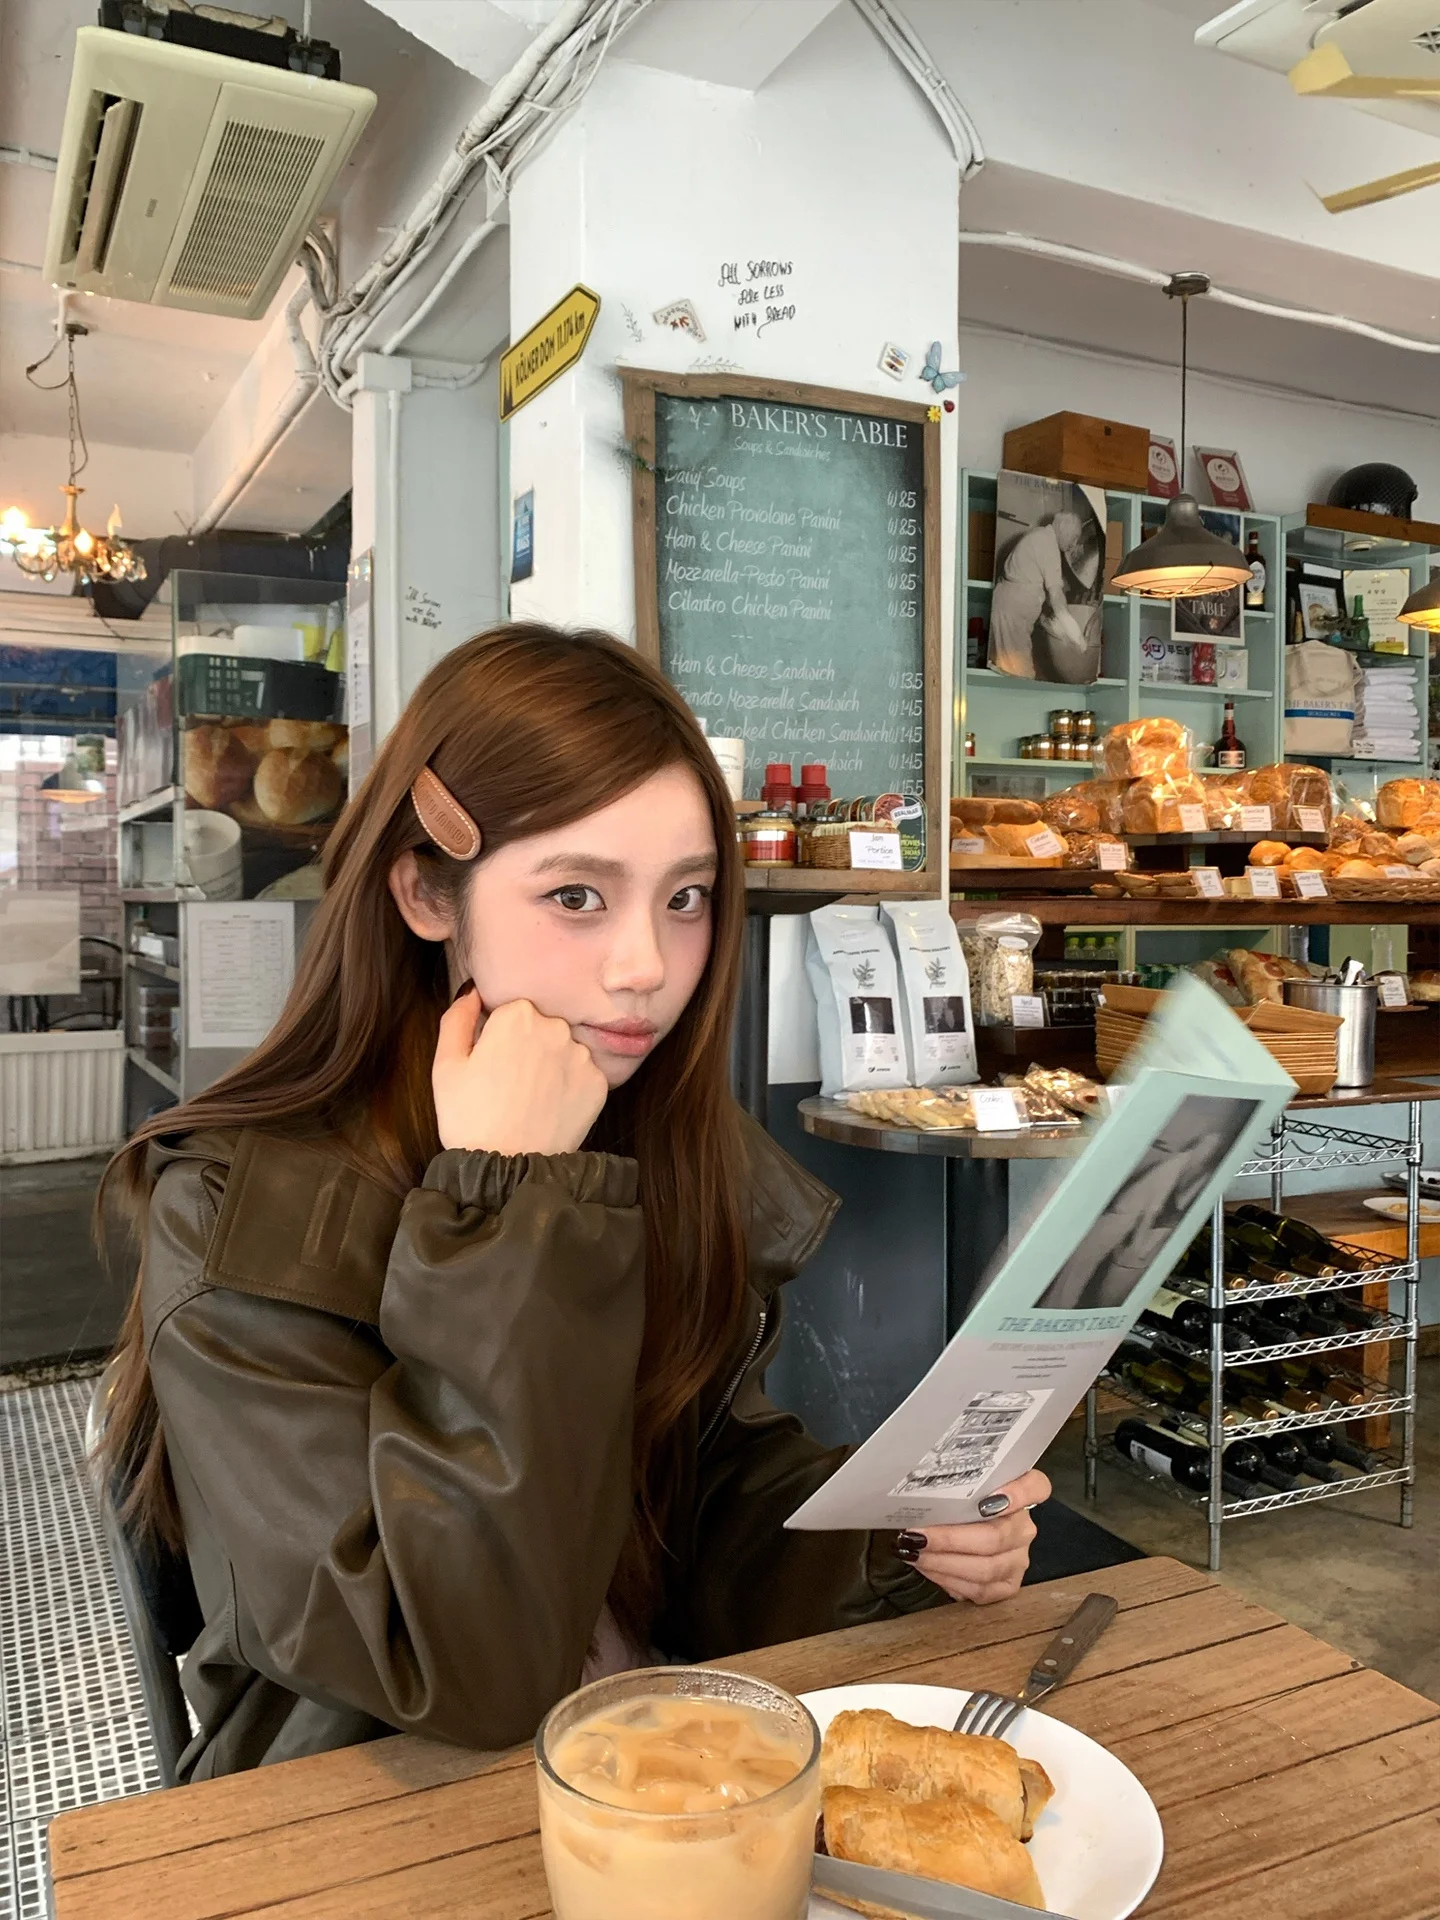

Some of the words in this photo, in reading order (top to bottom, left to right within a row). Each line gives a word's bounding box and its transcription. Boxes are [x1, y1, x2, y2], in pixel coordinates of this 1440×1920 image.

[745, 260, 793, 281] SORROWS
[738, 289, 759, 305] ARE
[764, 284, 784, 299] LESS
[515, 346, 539, 388] KÖLNER
[540, 332, 555, 367] DOM
[575, 311, 585, 336] km
[731, 402, 828, 438] BAKER'S
[834, 416, 908, 448] TABLE
[734, 436, 764, 458] Soups
[765, 442, 774, 455] &
[775, 441, 831, 461] Sandwiches
[703, 466, 747, 497] Soups
[666, 491, 725, 521] Chicken
[727, 500, 797, 526] Provolone
[798, 507, 842, 530] Panini
[665, 526, 697, 549] Ham
[700, 530, 712, 552] &
[716, 528, 766, 555] Cheese
[768, 535, 813, 559] Panini
[786, 568, 831, 592] Panini
[668, 589, 726, 613] Cilantro
[732, 592, 788, 620] Chicken
[789, 599, 834, 621] Panini
[1188, 600, 1226, 618] TABLE
[670, 653, 701, 676] Ham
[705, 654, 717, 677] &
[720, 653, 769, 680] Cheese
[770, 658, 836, 682] Sandwich
[726, 688, 795, 712] Mozzarella
[797, 690, 860, 713] Sandwich
[713, 713, 770, 742] Smoked
[771, 717, 826, 743] Chicken
[827, 720, 889, 744] Sandwich
[997, 1316, 1034, 1332] THE
[1086, 1314, 1128, 1331] TABLE
